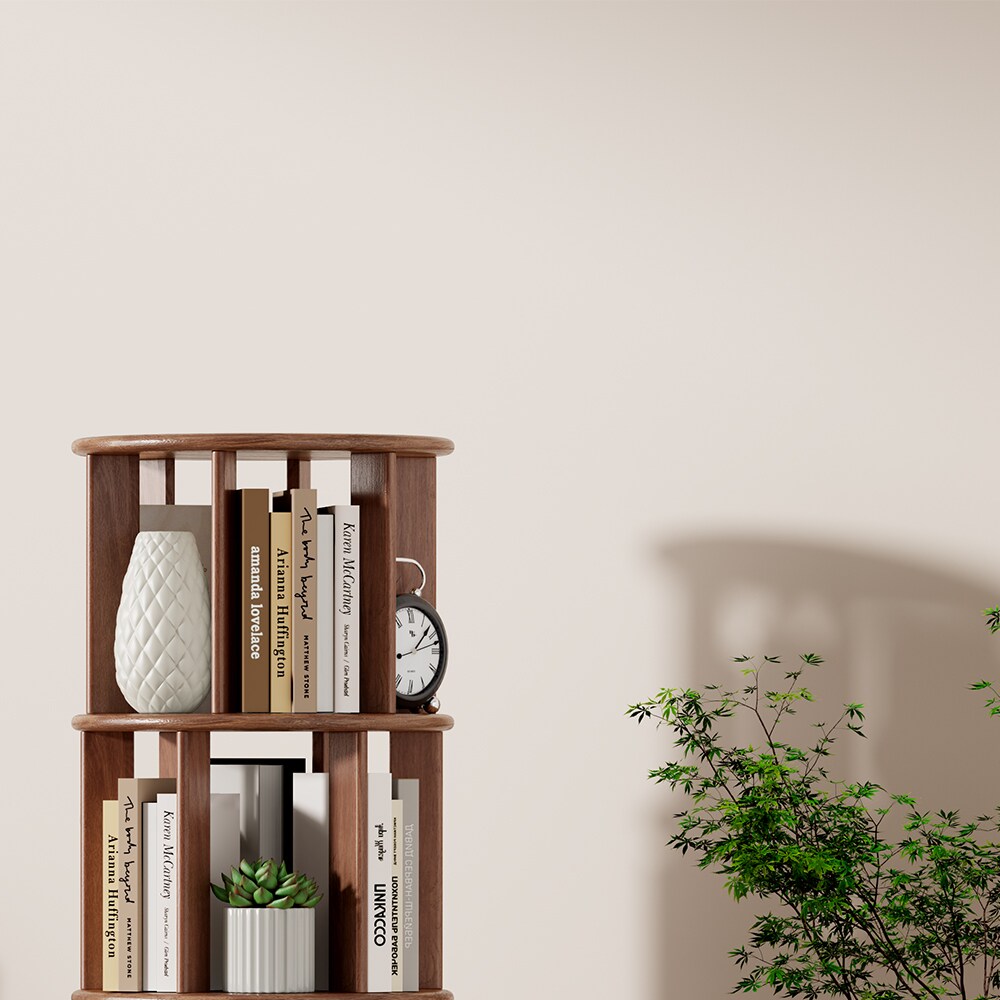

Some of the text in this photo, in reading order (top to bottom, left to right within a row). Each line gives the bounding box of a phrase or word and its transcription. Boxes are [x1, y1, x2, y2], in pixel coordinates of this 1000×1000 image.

[250, 546, 263, 660] amanda lovelace
[273, 548, 289, 678] Arianna Huffington
[339, 522, 355, 616] Karen McCartney
[105, 834, 118, 958] Arianna Huffington
[160, 810, 174, 900] Karen McCartney
